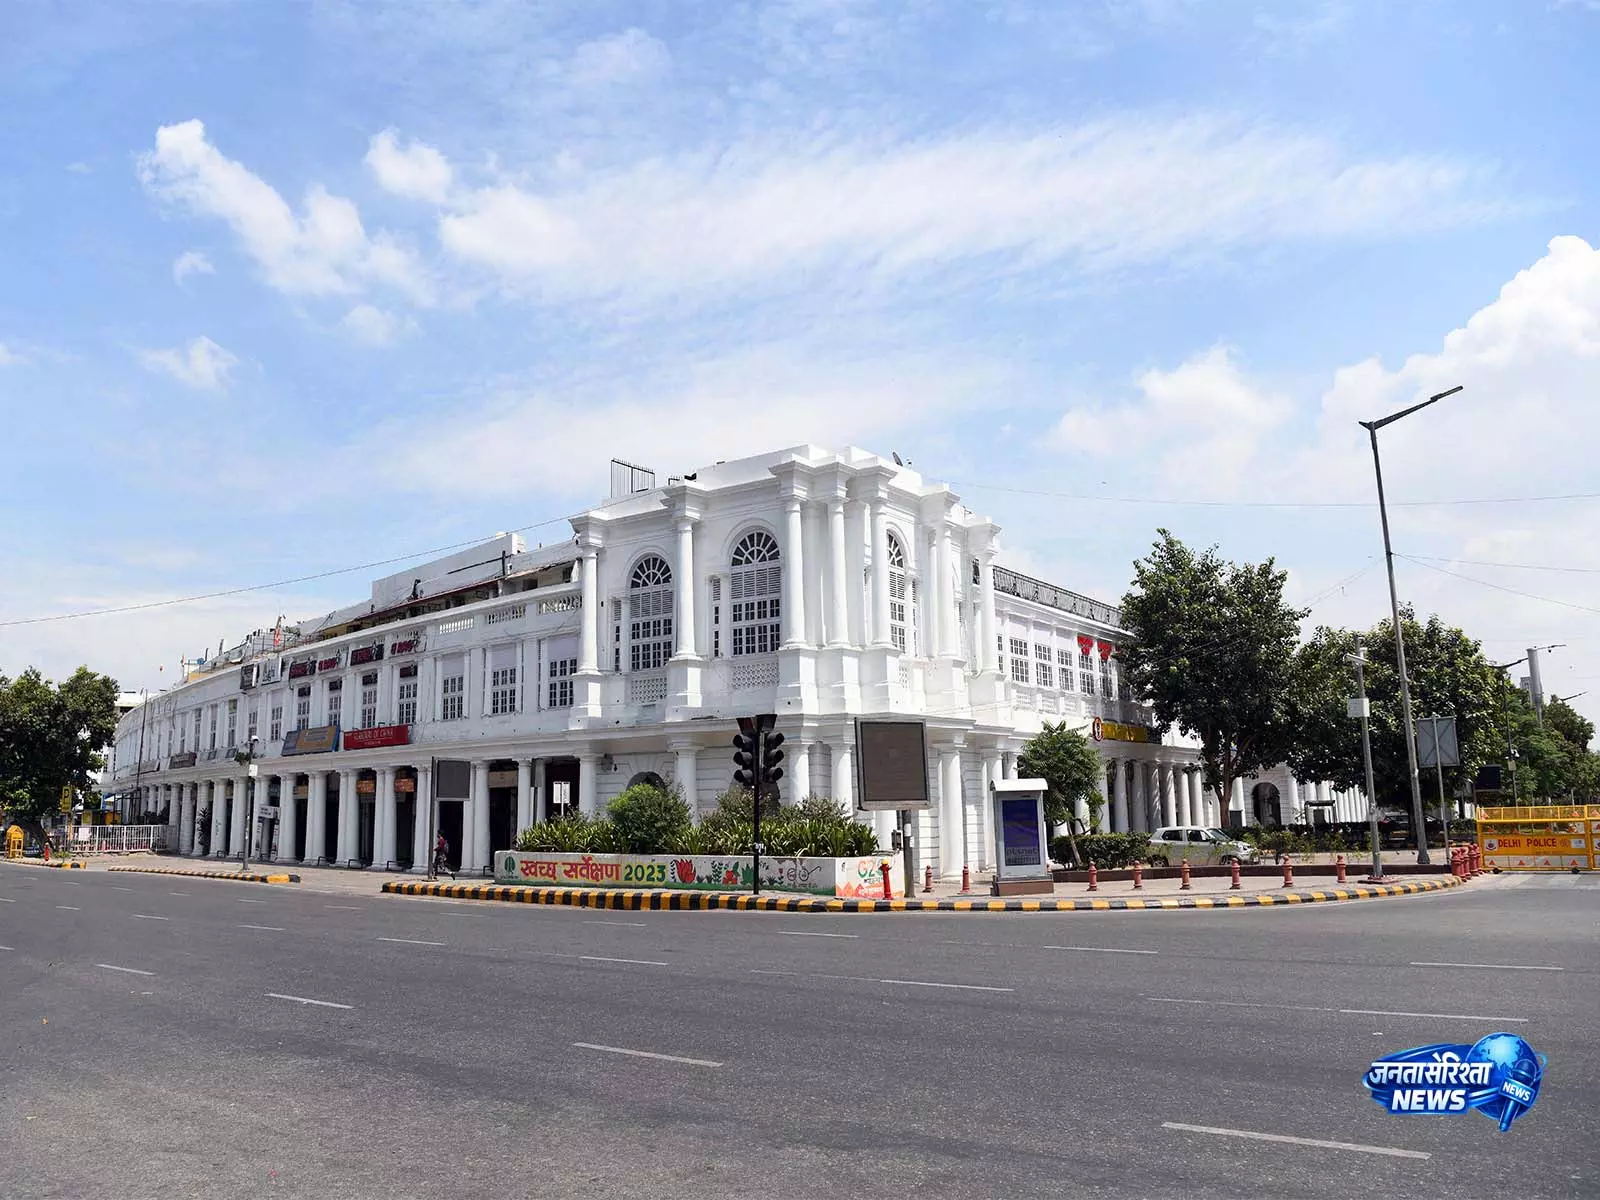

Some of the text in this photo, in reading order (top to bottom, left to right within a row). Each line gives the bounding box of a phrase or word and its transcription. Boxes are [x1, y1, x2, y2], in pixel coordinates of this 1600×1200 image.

[1498, 839, 1521, 848] DELHI
[1526, 838, 1557, 848] POLICE
[623, 863, 667, 883] 2023
